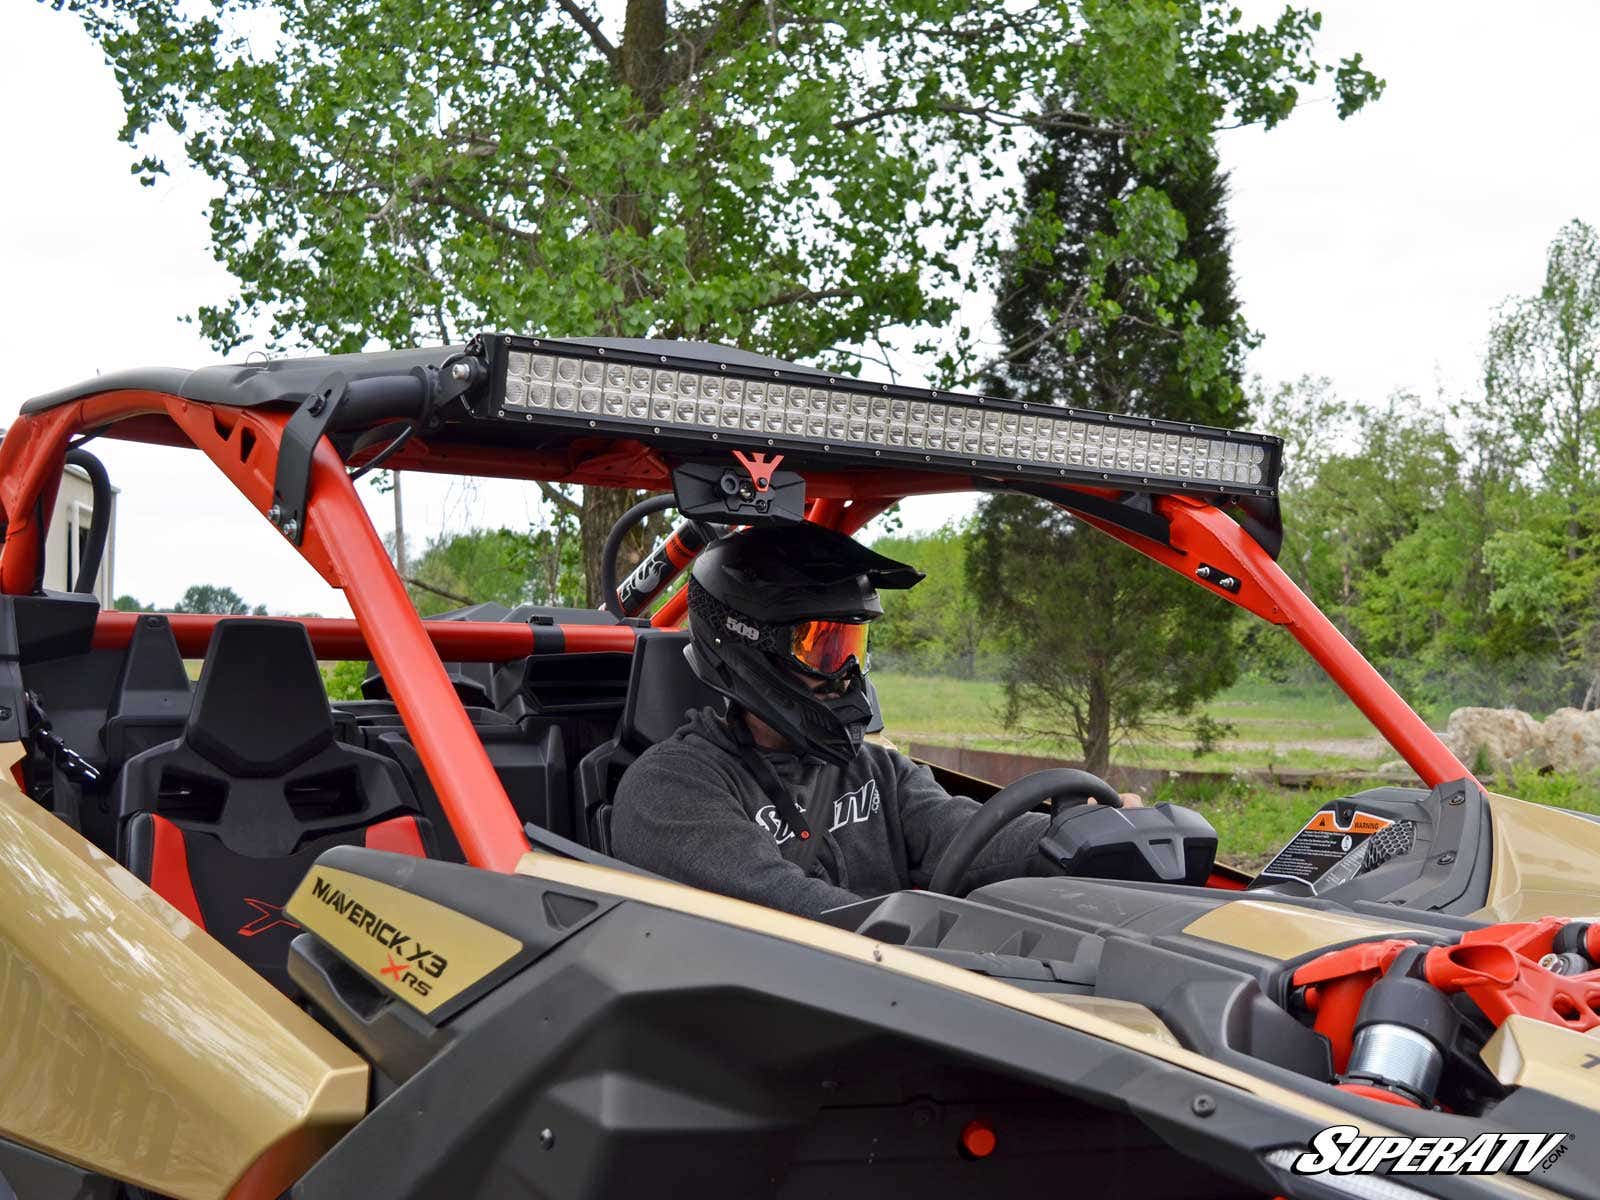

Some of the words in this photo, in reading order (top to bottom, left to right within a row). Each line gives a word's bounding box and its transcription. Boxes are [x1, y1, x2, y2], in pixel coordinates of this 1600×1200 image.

[726, 616, 760, 641] 509
[1354, 821, 1380, 831] WARNING
[311, 876, 410, 956] MAVERICK
[406, 942, 448, 979] X3
